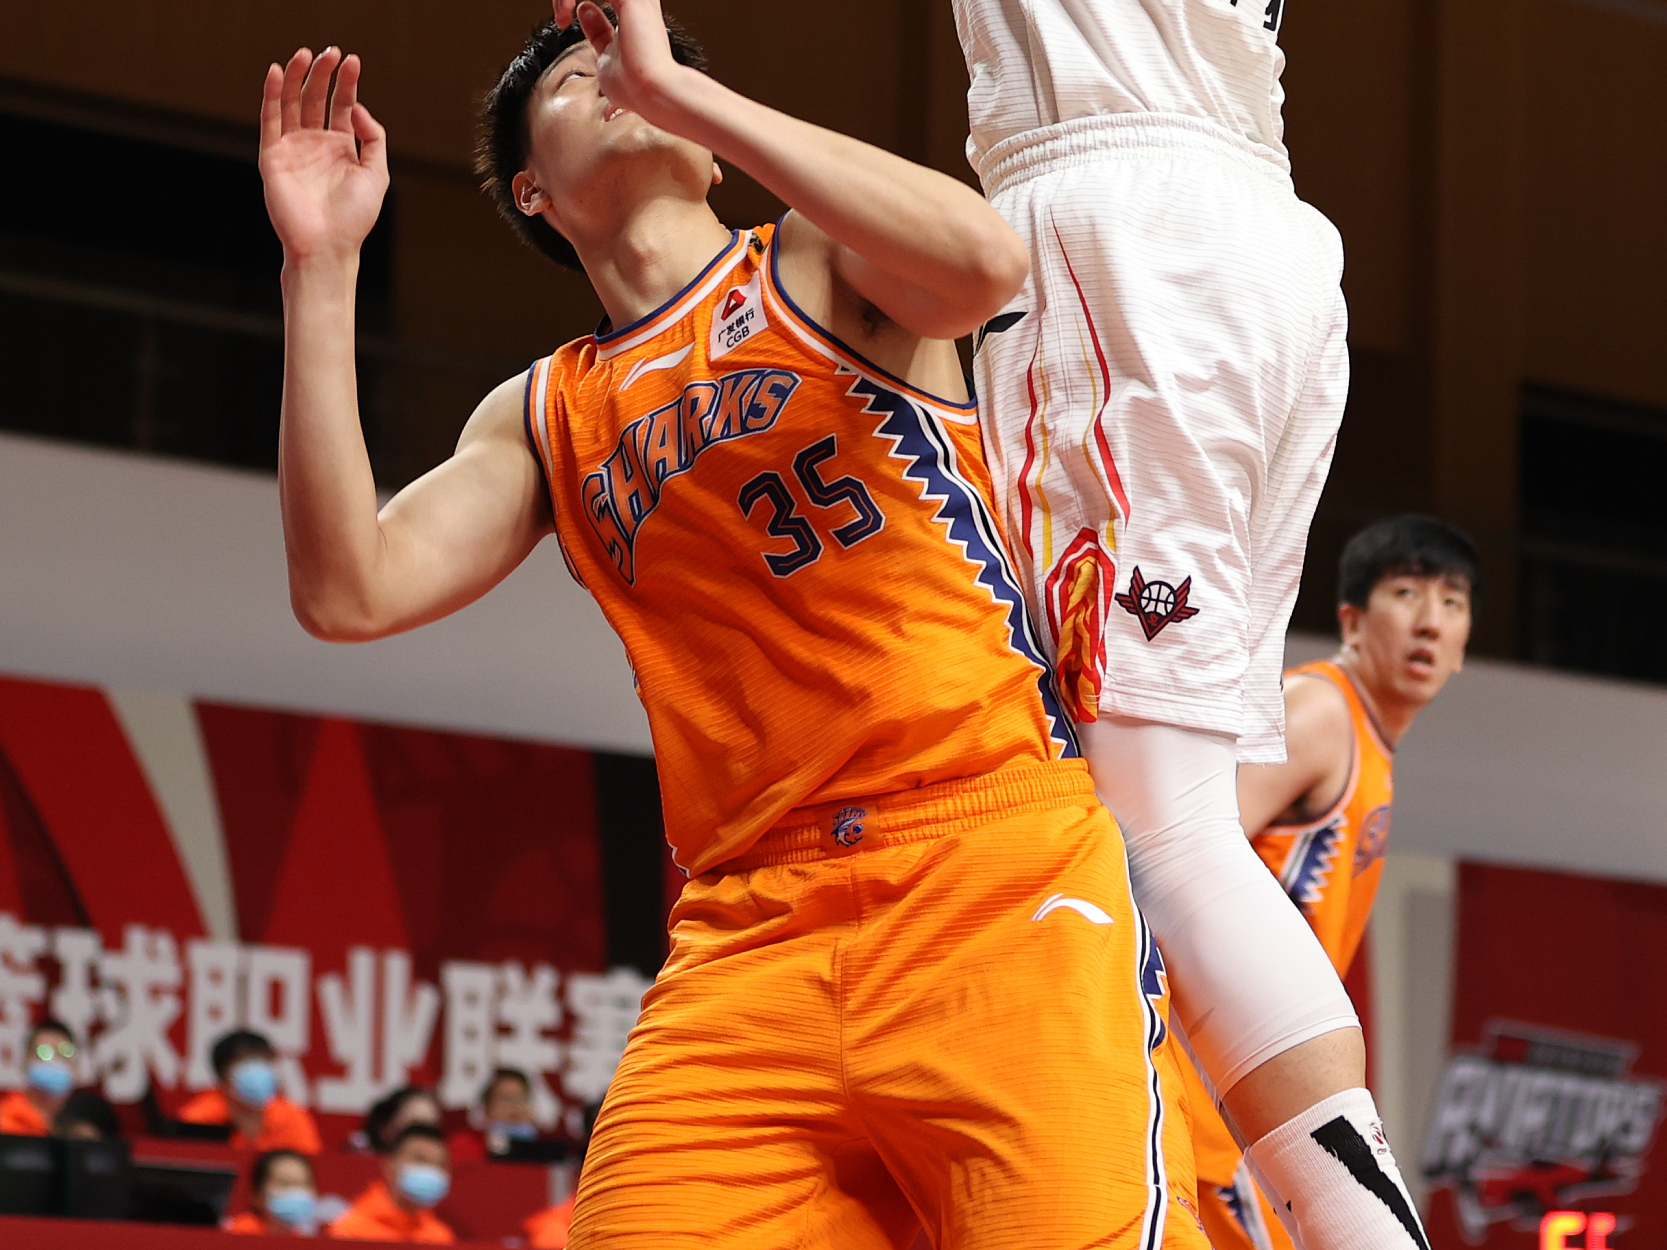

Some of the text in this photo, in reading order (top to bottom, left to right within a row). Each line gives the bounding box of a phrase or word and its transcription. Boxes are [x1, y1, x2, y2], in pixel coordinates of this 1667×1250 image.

[718, 307, 755, 343] 广发银行
[726, 325, 750, 348] CGB
[581, 368, 802, 587] SHARKS
[737, 433, 886, 578] 35
